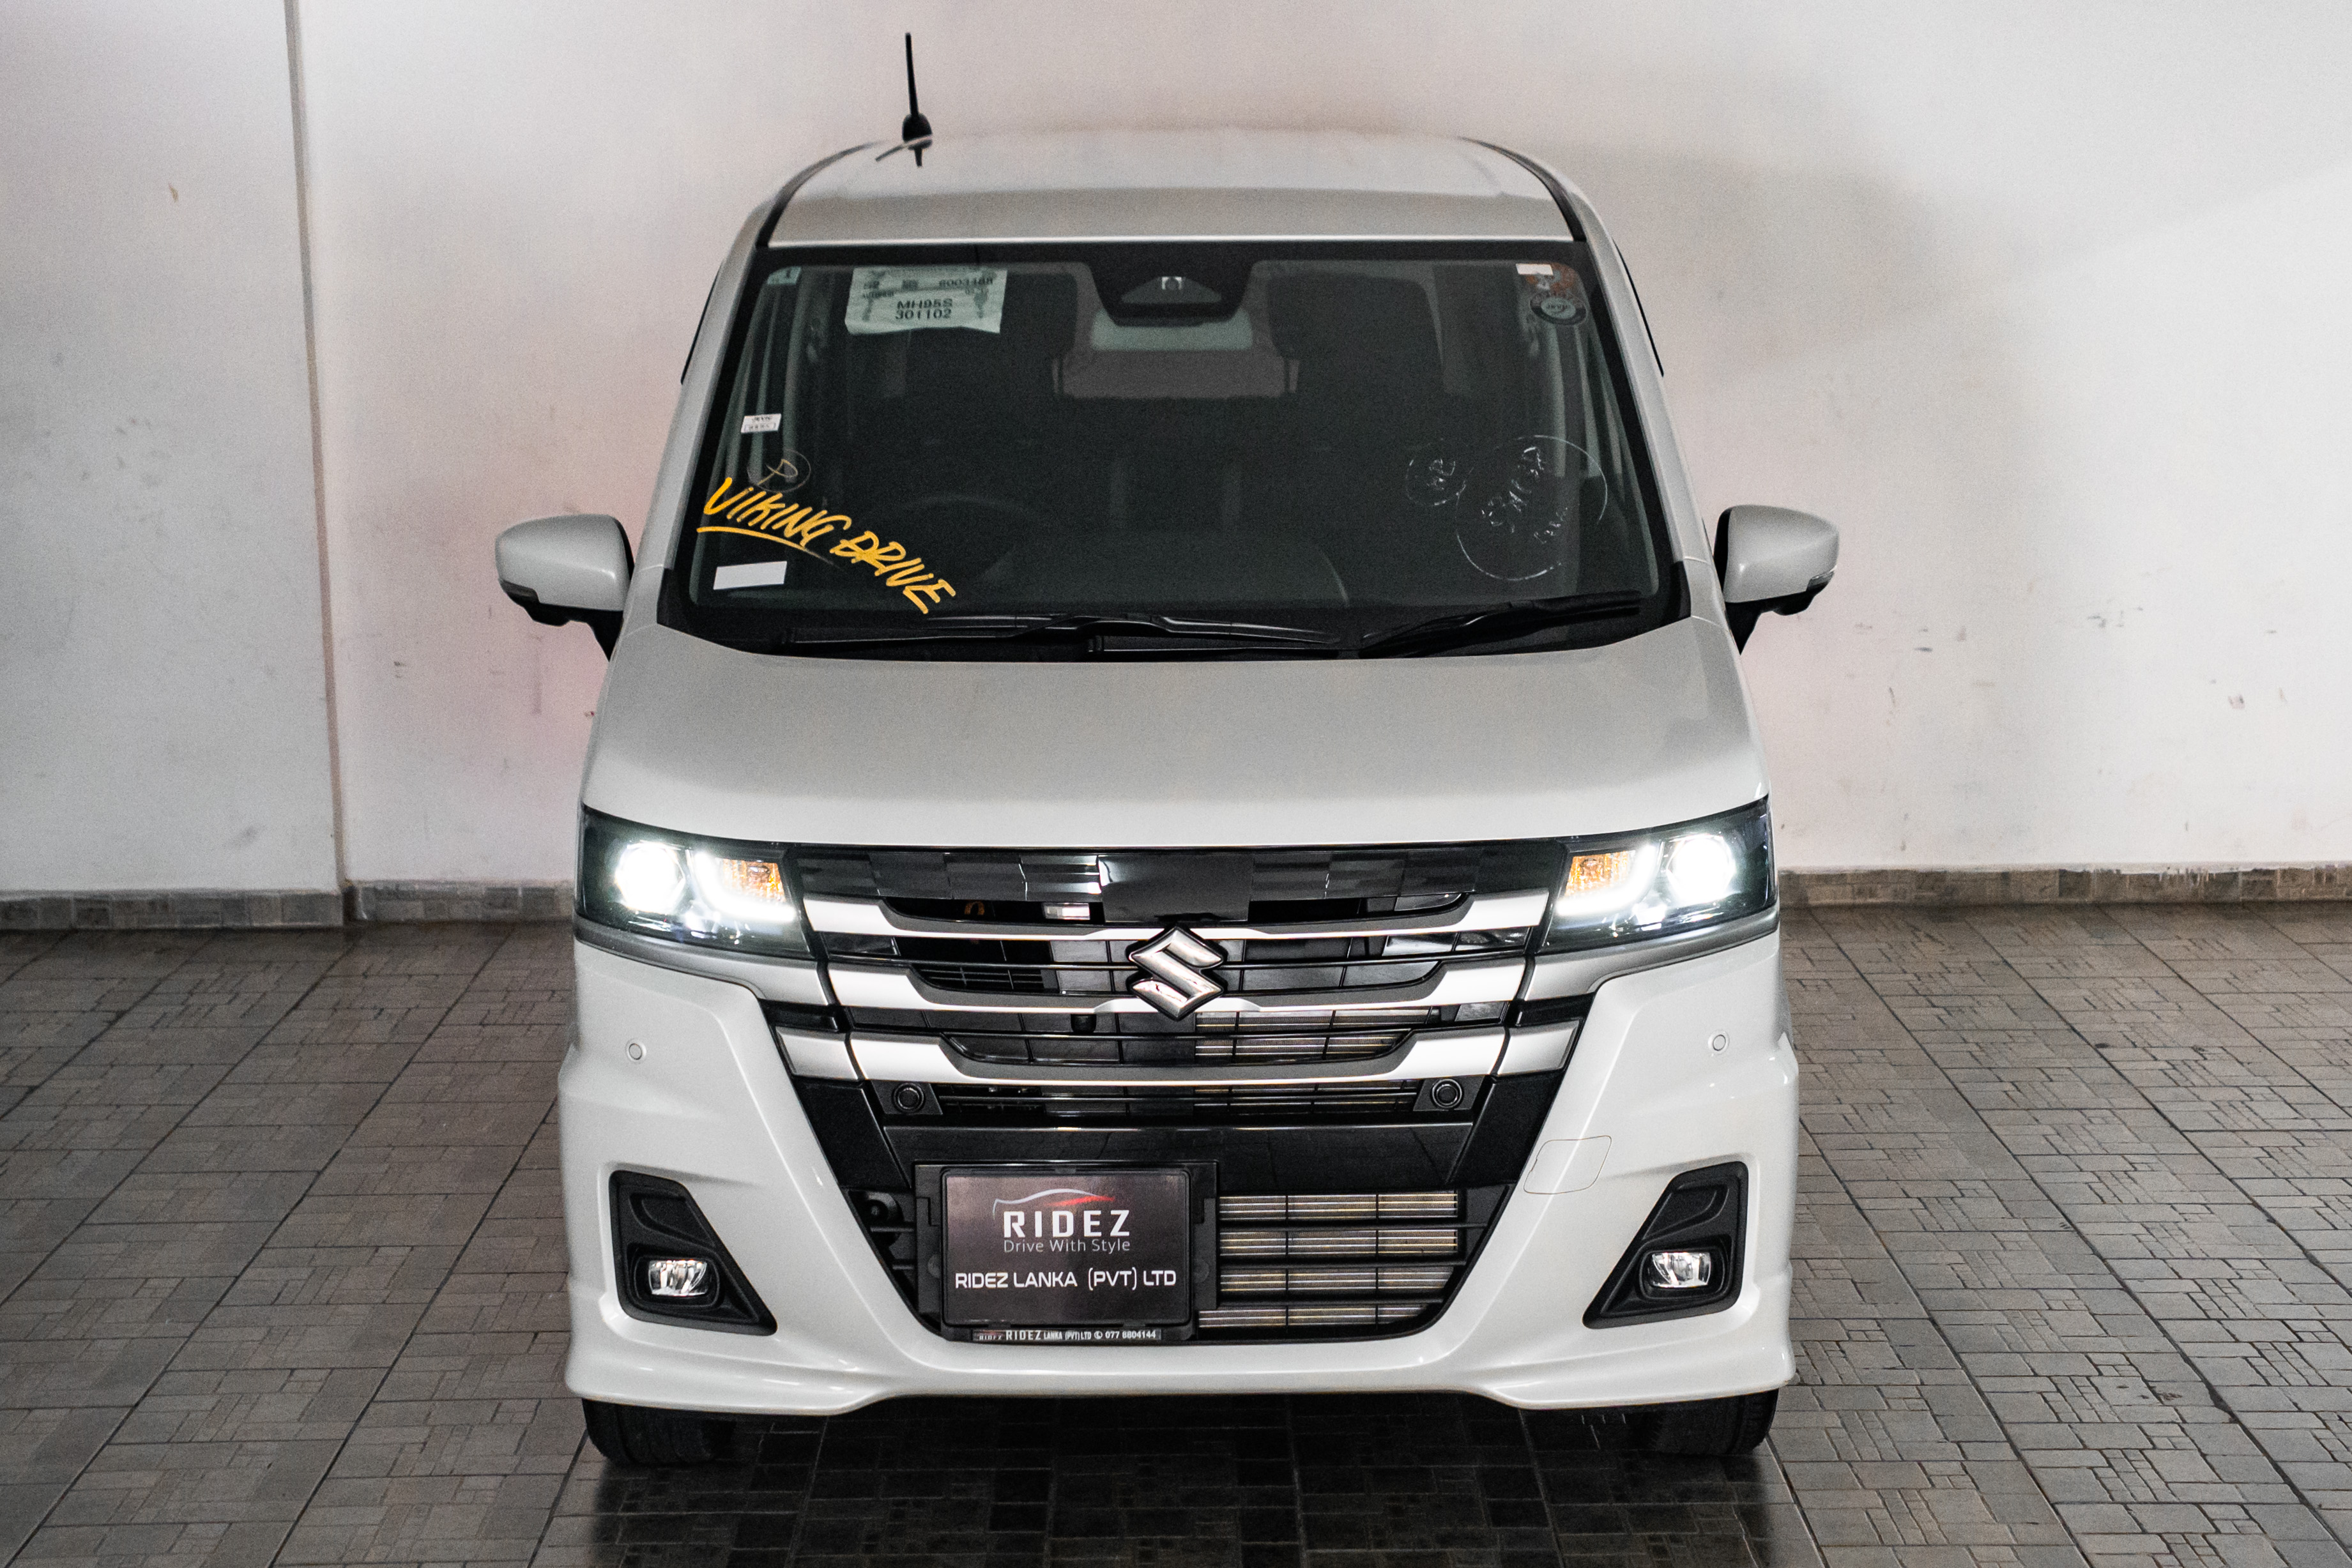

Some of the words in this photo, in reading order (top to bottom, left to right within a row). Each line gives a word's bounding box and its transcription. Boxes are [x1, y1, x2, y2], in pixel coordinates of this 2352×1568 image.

[897, 298, 952, 309] MH95S
[896, 308, 952, 319] 301102
[703, 477, 852, 547] VIKING
[829, 531, 956, 614] DRIVE
[1004, 1209, 1130, 1238] RIDEZ
[1004, 1239, 1044, 1253] Drive
[1050, 1238, 1086, 1252] With
[1092, 1238, 1130, 1254] Style
[955, 1272, 1009, 1289] RIDEZ
[1013, 1271, 1078, 1288] LANKA
[1088, 1267, 1137, 1291] (PVT)
[1143, 1270, 1177, 1286] LTD
[1005, 1330, 1041, 1341] RIDEZ
[1043, 1330, 1063, 1340] LANKA
[1065, 1330, 1080, 1341] (PVT)
[1081, 1330, 1092, 1340] LTD
[1105, 1330, 1120, 1339] 077
